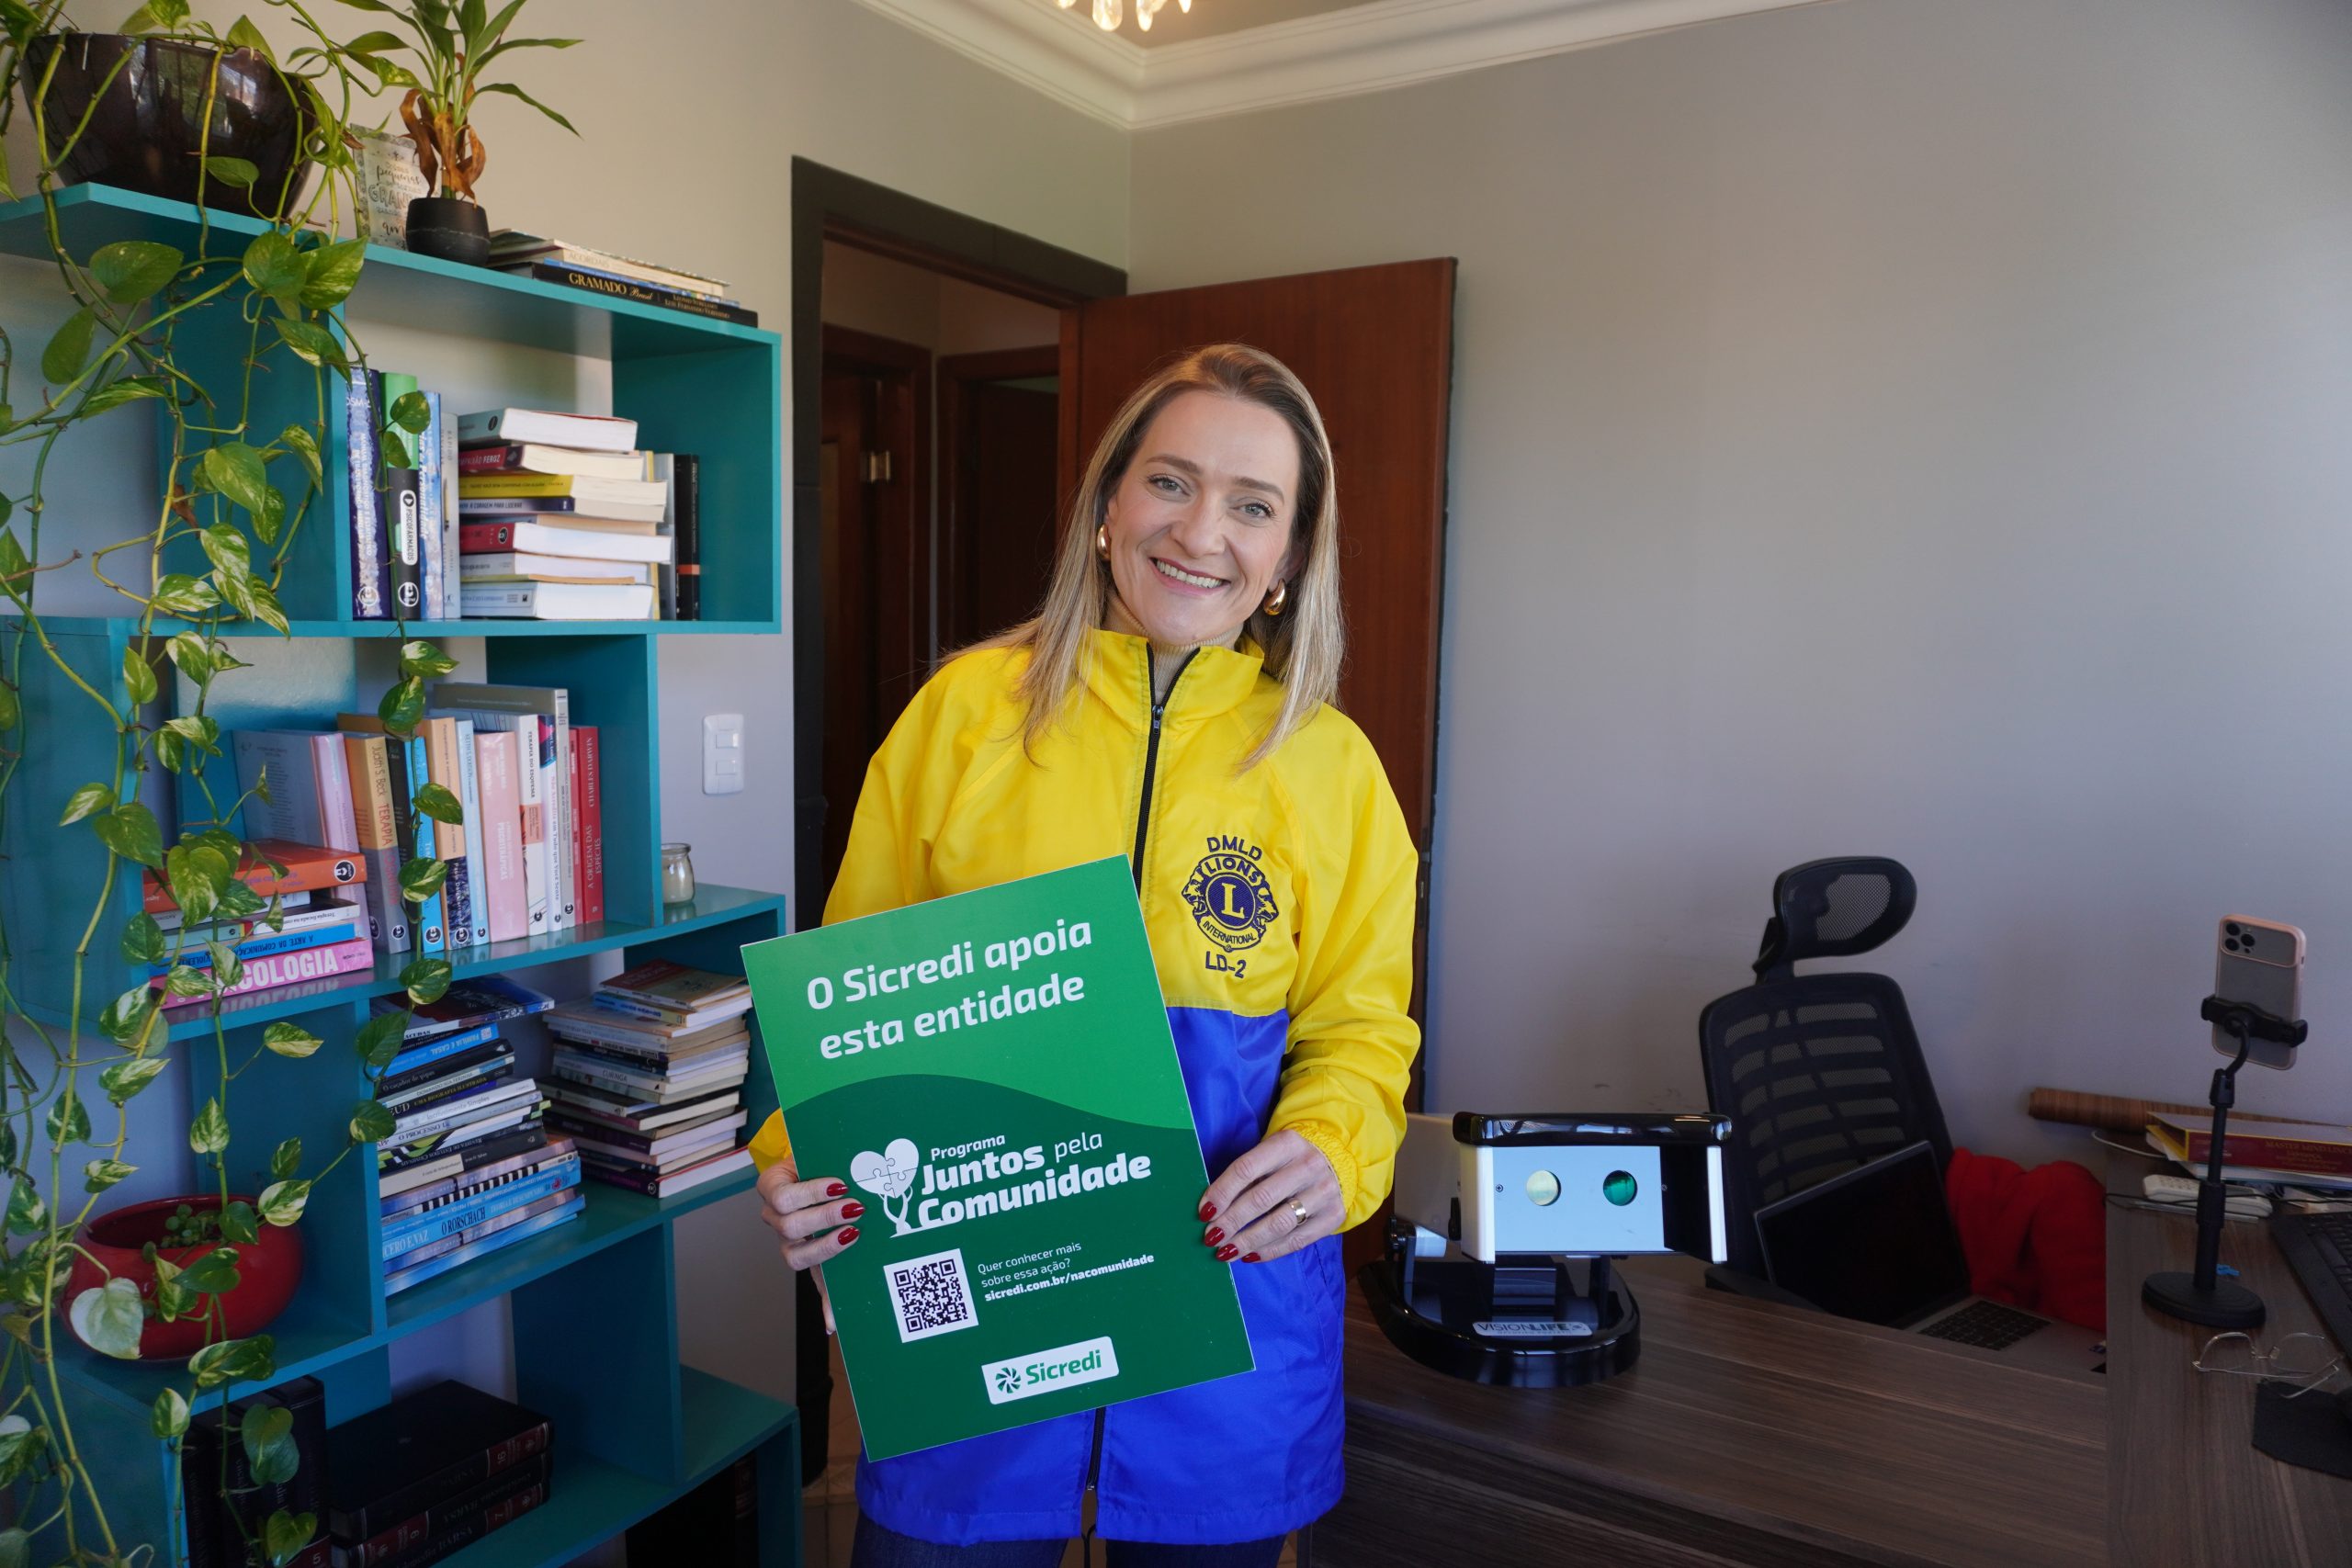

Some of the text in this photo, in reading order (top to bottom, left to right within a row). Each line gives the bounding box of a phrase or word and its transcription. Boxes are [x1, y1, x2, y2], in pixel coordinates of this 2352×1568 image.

[569, 272, 627, 295] GRAMADO
[371, 745, 382, 770] Judith
[586, 737, 595, 807] CHARLES DARWIN
[376, 778, 387, 797] Beck
[378, 803, 393, 847] TERAPIA
[1206, 835, 1263, 862] DMLD
[1204, 857, 1262, 884] LIONS
[1221, 882, 1245, 919] L
[1202, 920, 1257, 944] INTERNATIONAL
[808, 919, 1091, 1009] O Sicredi apoia
[1205, 951, 1247, 979] LD-2
[820, 974, 1085, 1058] esta entidade
[931, 1134, 1005, 1161] Programa
[922, 1132, 1102, 1195] Juntos pela
[919, 1153, 1151, 1230] Comunidade
[447, 1207, 486, 1234] RORSCHACH
[978, 1242, 1081, 1275] Quer conhecer mais
[981, 1258, 1071, 1288] sobre essa ação?
[984, 1254, 1155, 1302] sicredi.com.br/nacomunidade
[1477, 1323, 1569, 1331] VISIONLIFE
[1025, 1349, 1102, 1385] Sicredi
